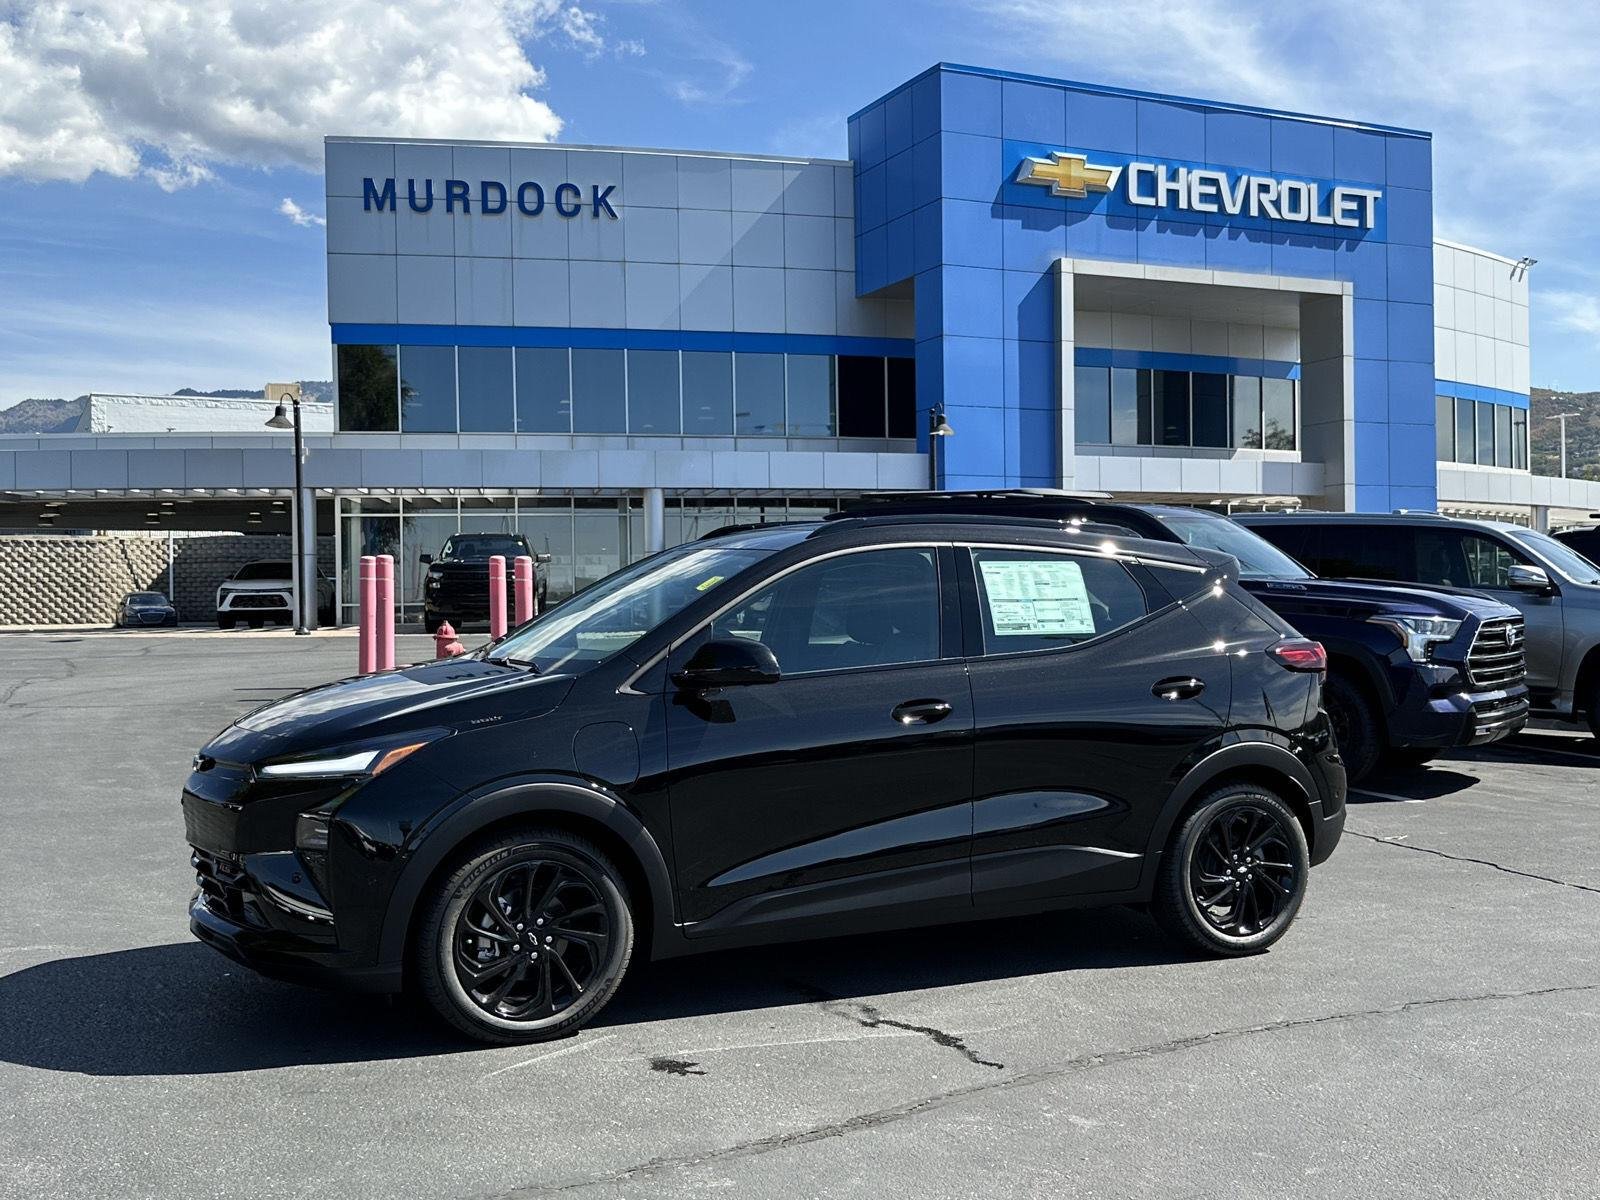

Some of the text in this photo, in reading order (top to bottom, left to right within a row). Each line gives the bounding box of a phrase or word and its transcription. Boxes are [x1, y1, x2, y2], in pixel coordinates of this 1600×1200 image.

[362, 177, 618, 219] MURDOCK
[1127, 161, 1382, 229] CHEVROLET
[463, 850, 508, 887] MICHELIN
